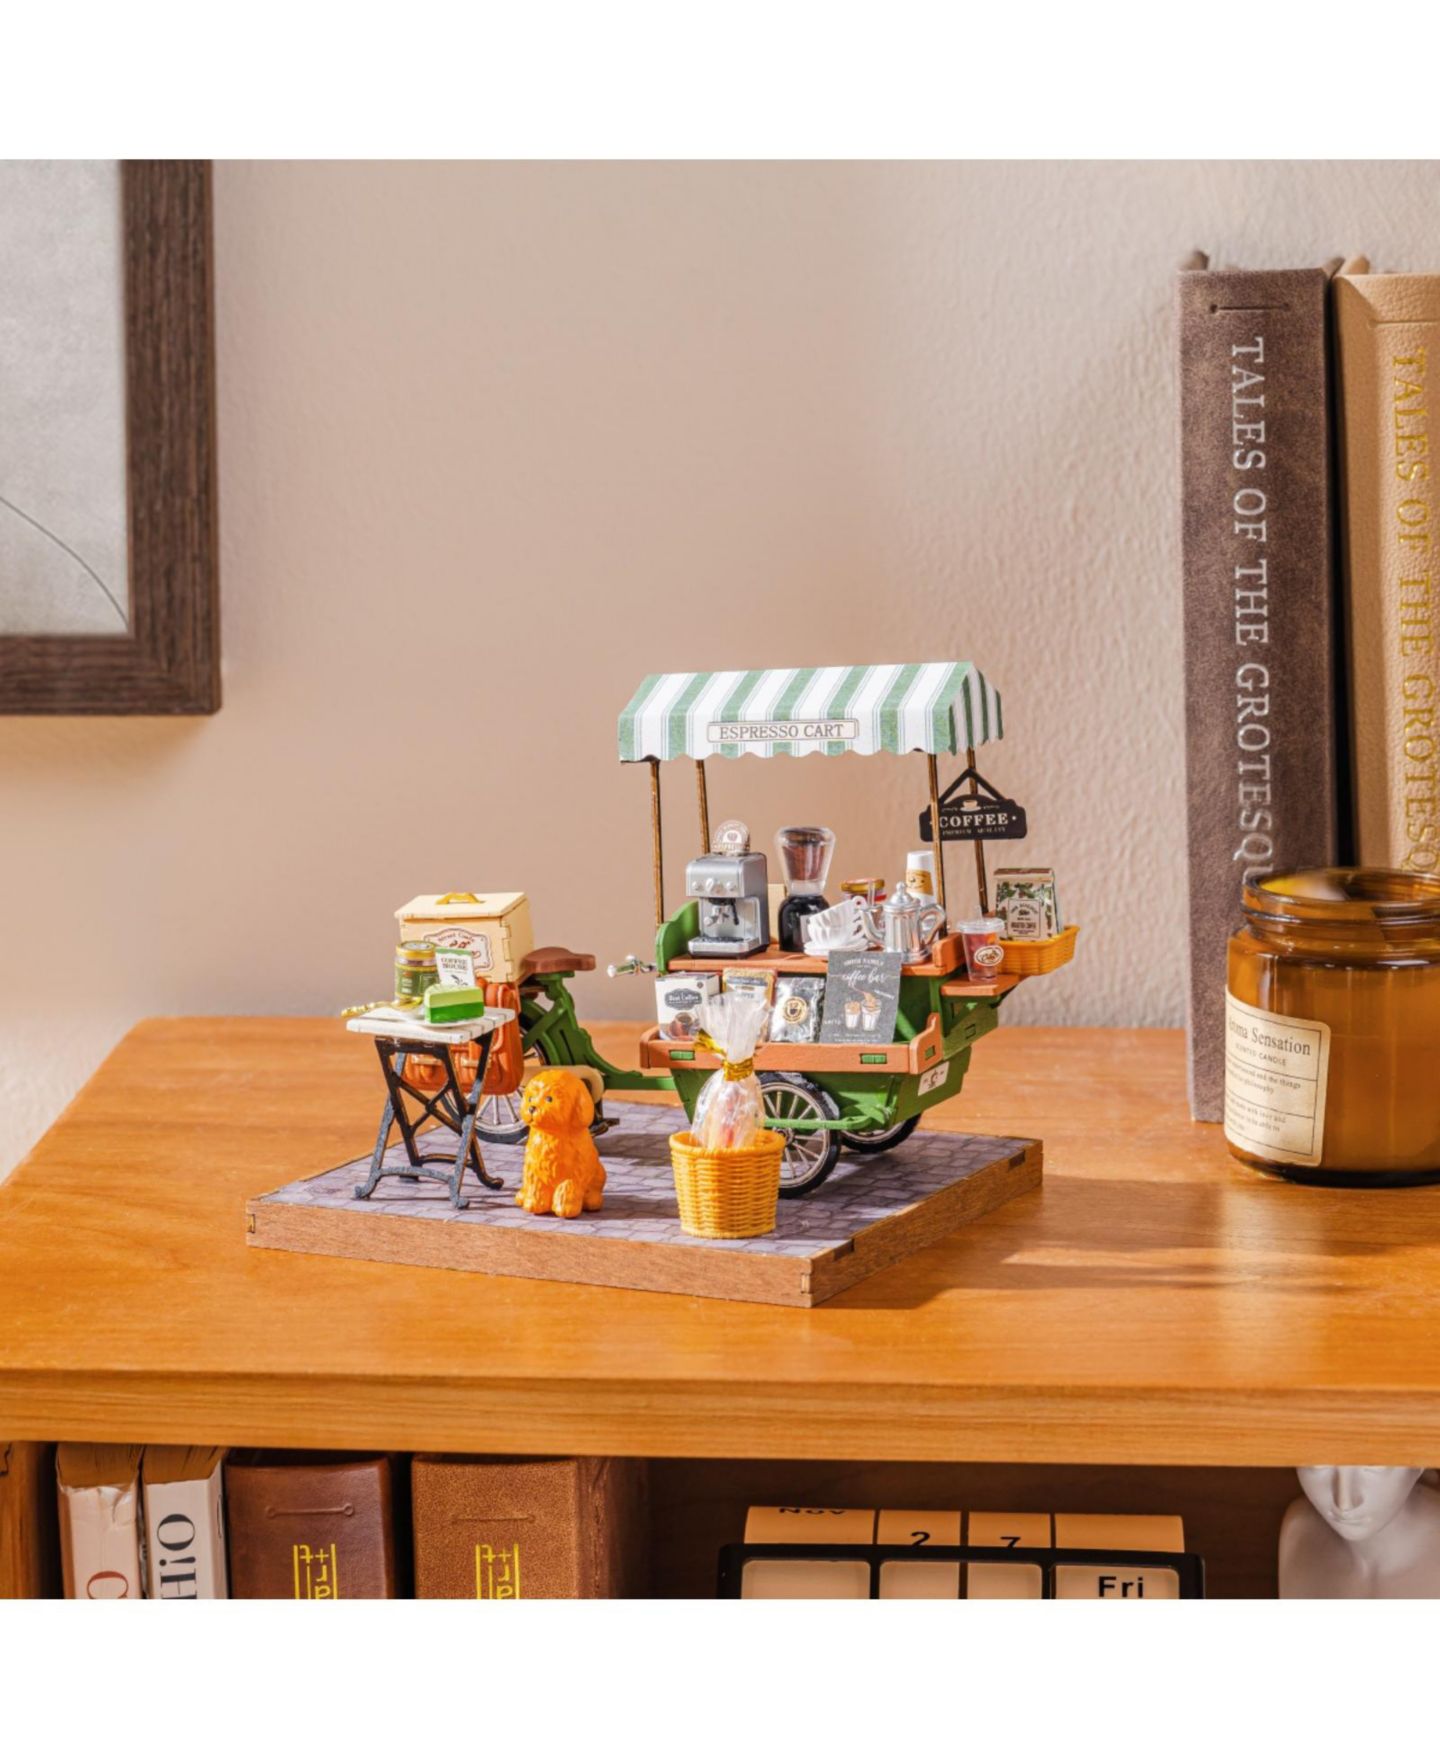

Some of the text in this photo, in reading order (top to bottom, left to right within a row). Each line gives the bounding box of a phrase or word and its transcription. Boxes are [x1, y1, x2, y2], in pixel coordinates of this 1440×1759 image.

[1232, 336, 1273, 885] TALES OF THE GROTESQU
[1392, 347, 1439, 870] TALES OF THE GROTESQ
[719, 724, 844, 740] ESPRESSO CART
[939, 813, 1009, 829] COFFEE
[1251, 1027, 1311, 1056] Sensation
[910, 1531, 931, 1545] 2
[1000, 1536, 1021, 1548] 7
[1098, 1575, 1144, 1598] Fri
